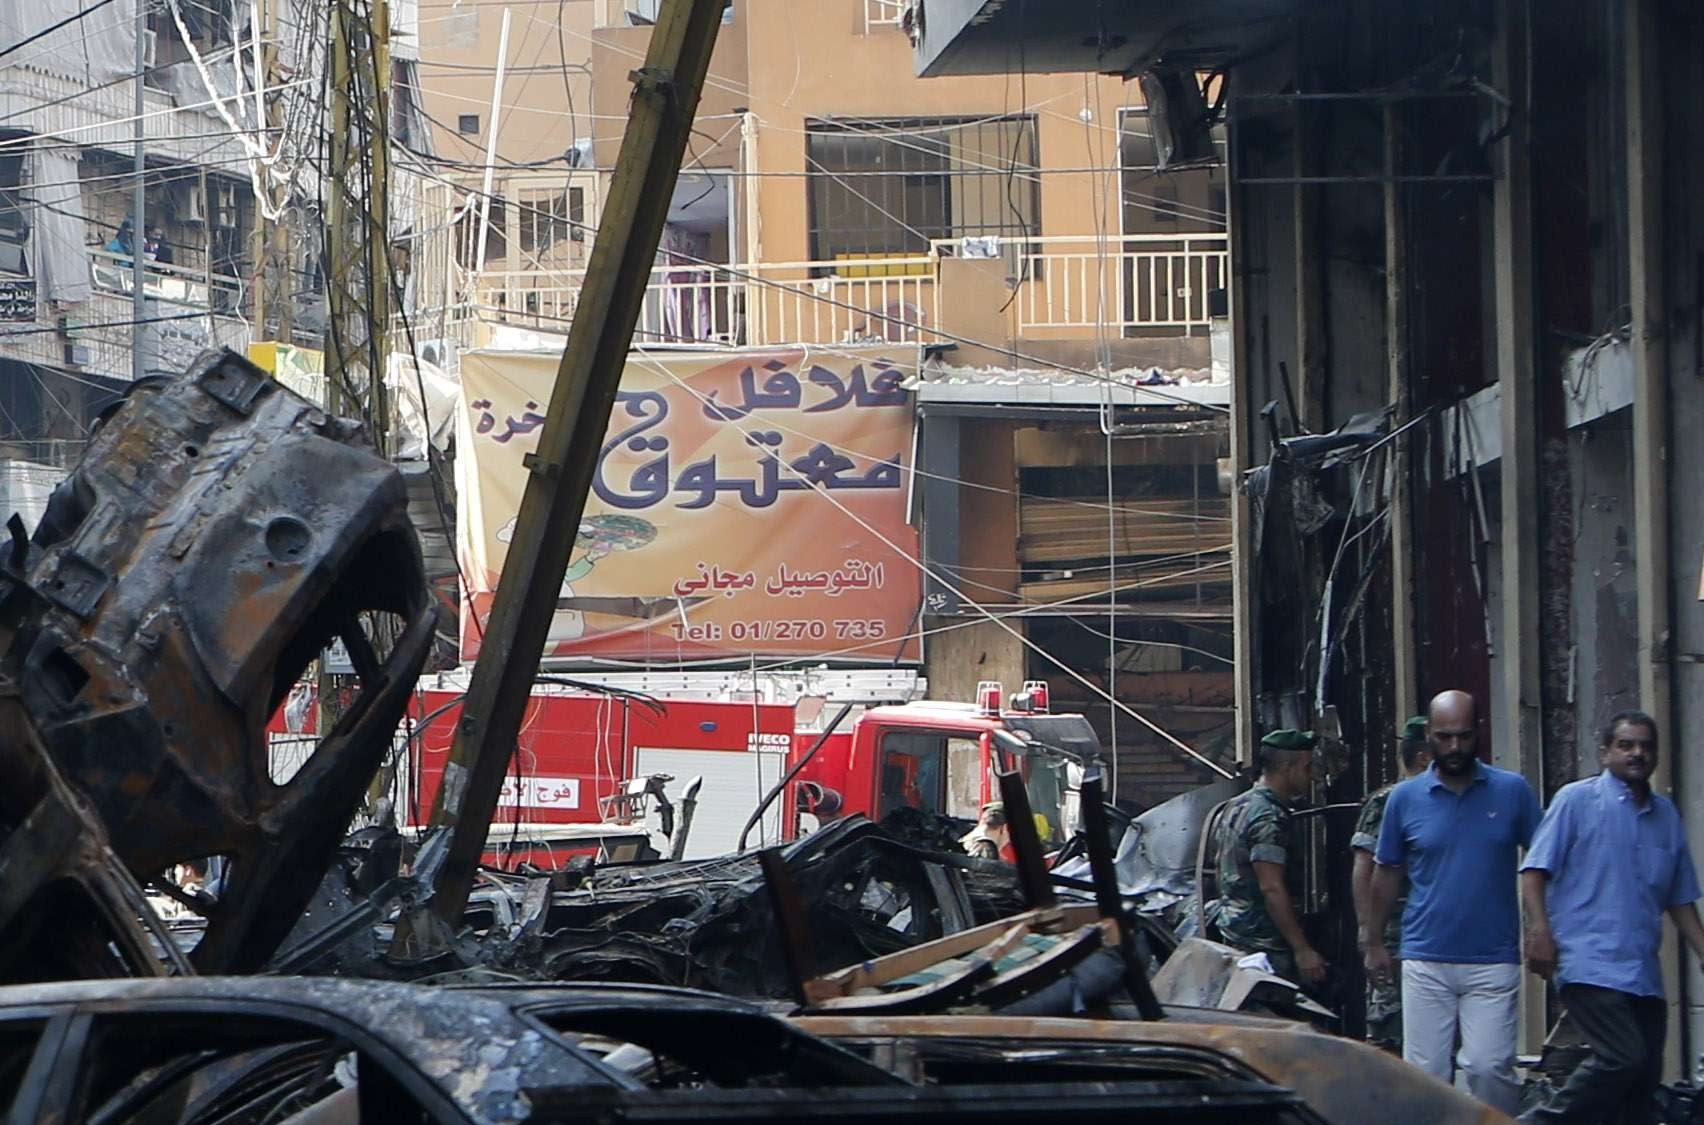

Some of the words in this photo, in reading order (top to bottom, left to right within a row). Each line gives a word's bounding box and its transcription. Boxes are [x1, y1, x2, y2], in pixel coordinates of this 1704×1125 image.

[702, 357, 911, 421] فلافل
[765, 561, 885, 597] التوصيل
[672, 623, 722, 641] Tel:
[730, 620, 825, 641] 01/270
[835, 620, 885, 639] 735
[748, 733, 791, 745] IVECO
[537, 783, 571, 803] فوج
